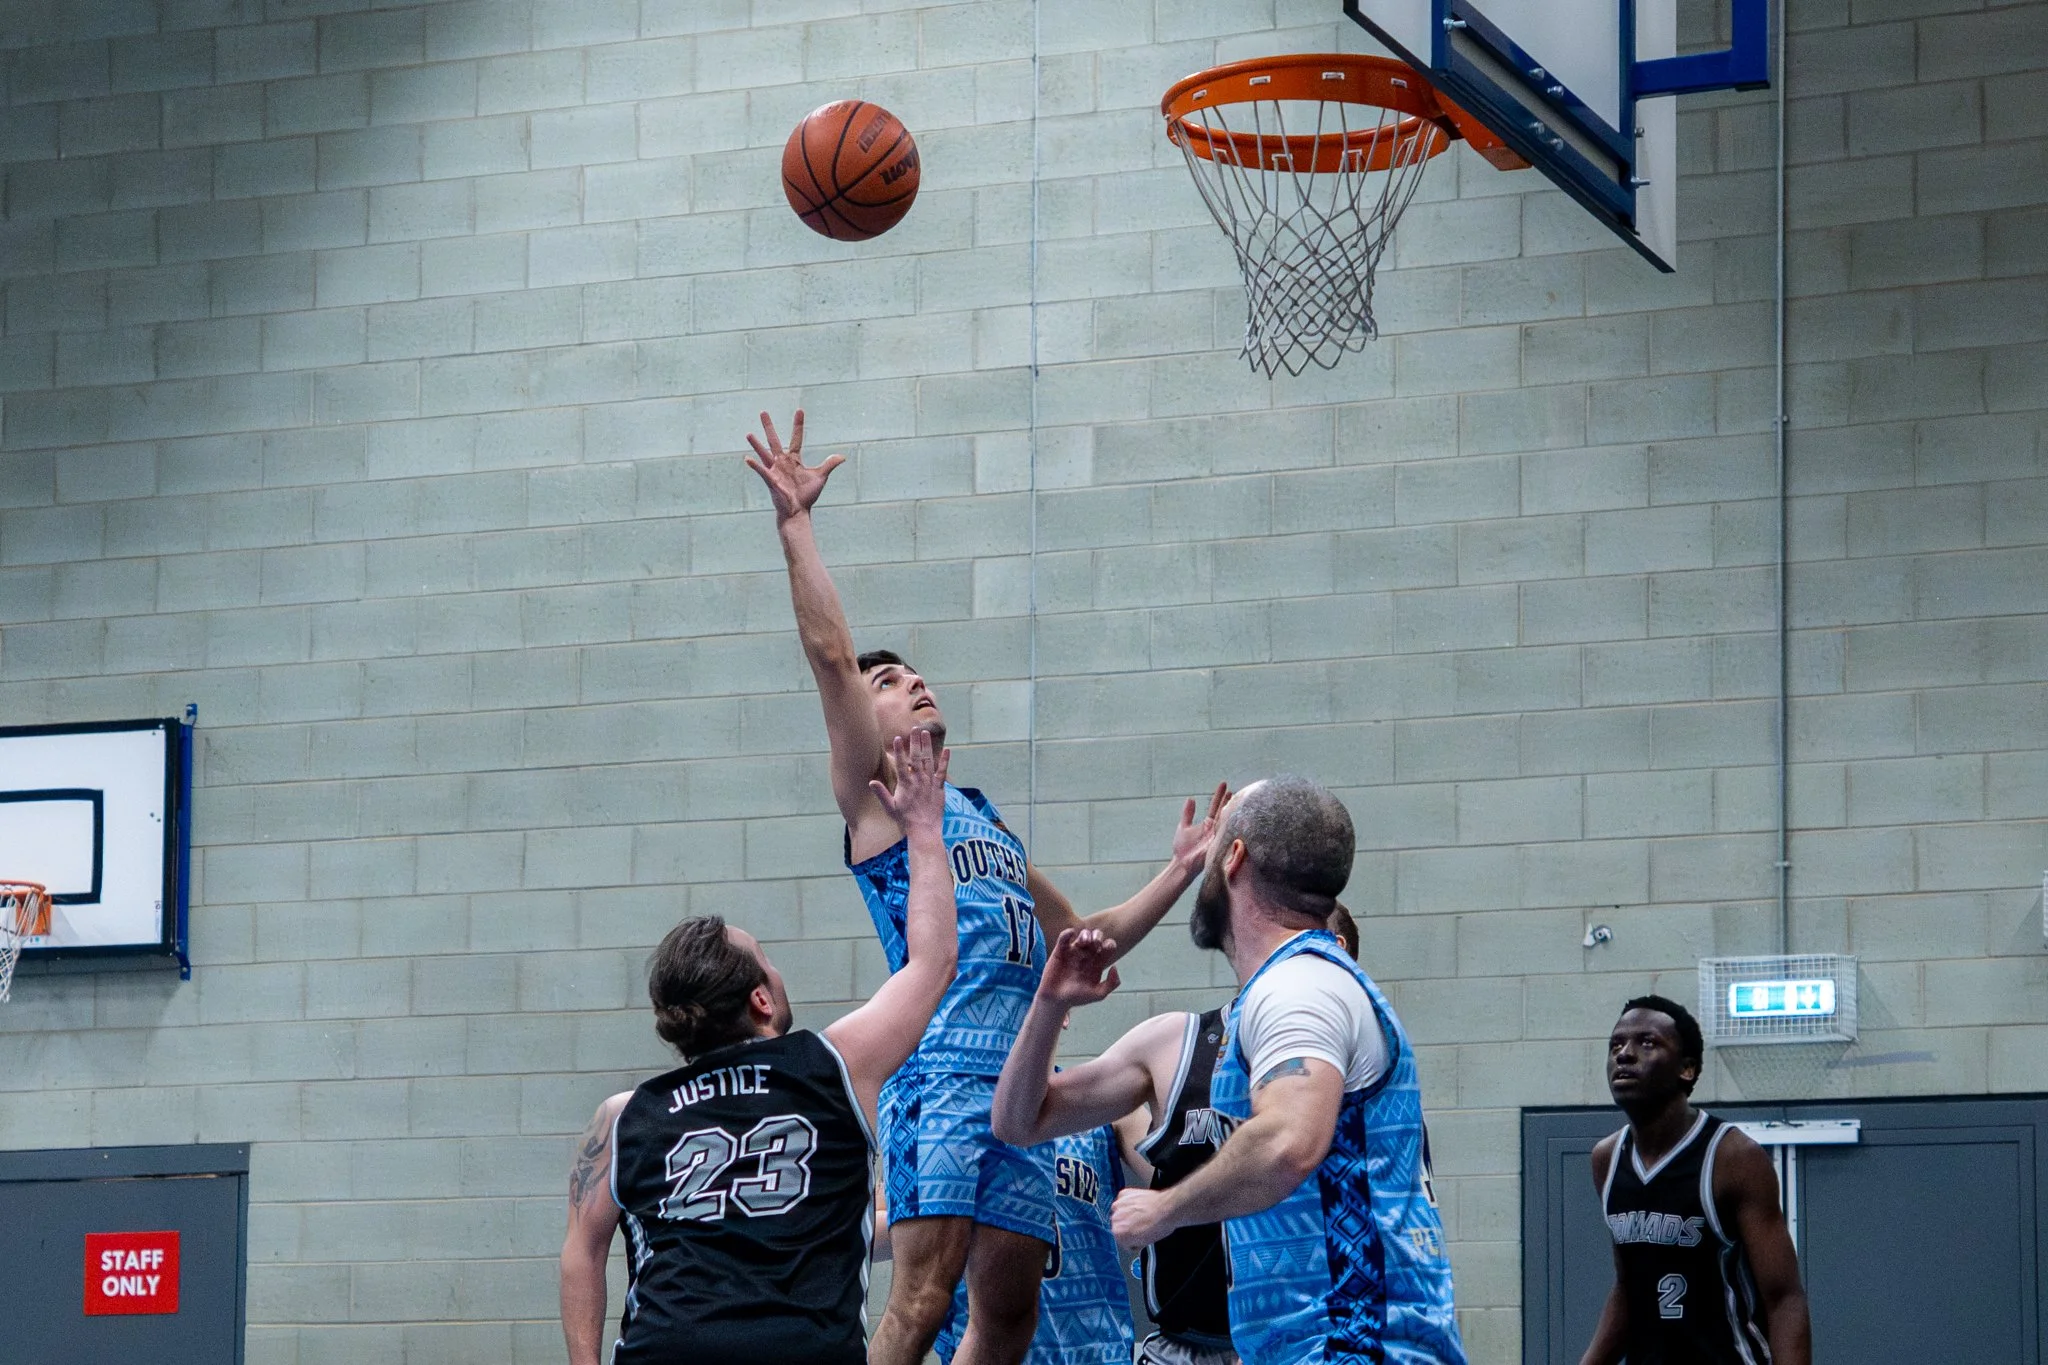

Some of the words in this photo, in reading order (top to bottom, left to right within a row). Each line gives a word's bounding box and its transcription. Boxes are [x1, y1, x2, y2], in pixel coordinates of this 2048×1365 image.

[951, 838, 1027, 888] OUTHS
[1002, 894, 1036, 968] 17
[668, 1064, 771, 1114] JUSTICE
[657, 1113, 818, 1222] 23
[101, 1248, 164, 1271] STAFF
[101, 1275, 160, 1297] ONLY
[1657, 1273, 1688, 1319] 2
